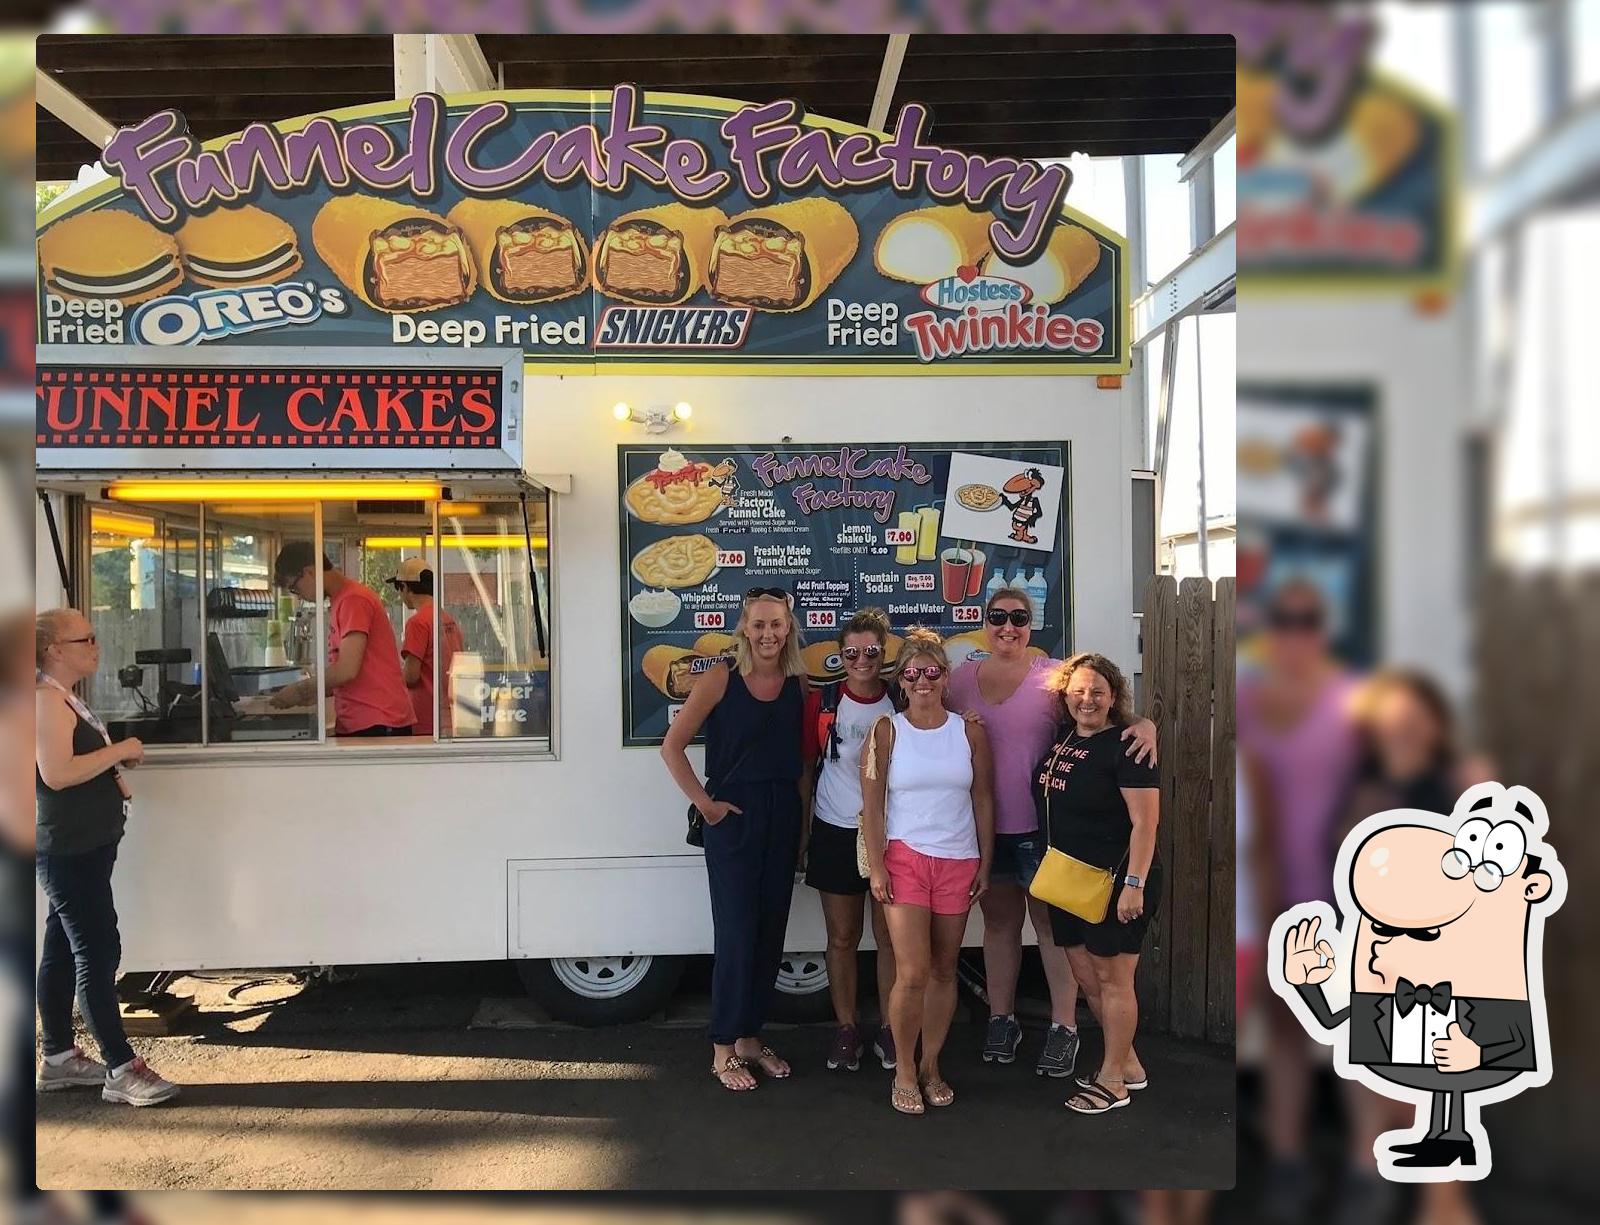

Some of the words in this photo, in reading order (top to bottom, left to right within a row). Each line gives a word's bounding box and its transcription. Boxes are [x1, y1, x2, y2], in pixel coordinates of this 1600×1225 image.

[104, 93, 443, 222] Funnel
[444, 82, 727, 196] Cake
[722, 100, 1071, 260] Factory
[938, 277, 1021, 305] Hostess
[47, 296, 123, 320] Deep
[828, 299, 898, 325] Deep
[47, 319, 123, 344] Fried
[392, 315, 486, 347] Deep
[495, 315, 586, 344] Fried
[600, 309, 750, 346] SNICKERS
[828, 323, 897, 345] Fried
[906, 304, 1100, 357] Twinkies
[37, 387, 259, 432] UNNEL
[287, 387, 495, 433] CAKES
[752, 446, 850, 488] Funnel
[849, 445, 931, 485] Cake
[740, 497, 774, 509] Factory
[792, 478, 896, 523] Factory
[728, 507, 760, 518] Funnel
[763, 507, 785, 518] Cake
[842, 523, 871, 534] Lemon
[836, 533, 864, 544] Shake
[864, 533, 878, 546] Up
[753, 545, 785, 557] Freshly
[786, 545, 812, 555] Made
[756, 556, 786, 566] Funnel
[787, 556, 810, 566] Cake
[859, 571, 899, 582] Fountain
[702, 584, 718, 593] Add
[797, 581, 810, 590] Add
[811, 581, 826, 590] Fruit
[826, 581, 850, 592] Topping
[866, 582, 894, 593] Sodas
[681, 593, 716, 604] Whipped
[717, 593, 741, 601] Cream
[888, 603, 919, 614] Bottled
[920, 604, 946, 614] Water
[955, 608, 979, 620] $2.50
[697, 613, 722, 626] $1.00
[474, 681, 533, 703] Order
[480, 706, 528, 722] Here
[1071, 749, 1090, 760] ME
[1056, 760, 1075, 773] THE
